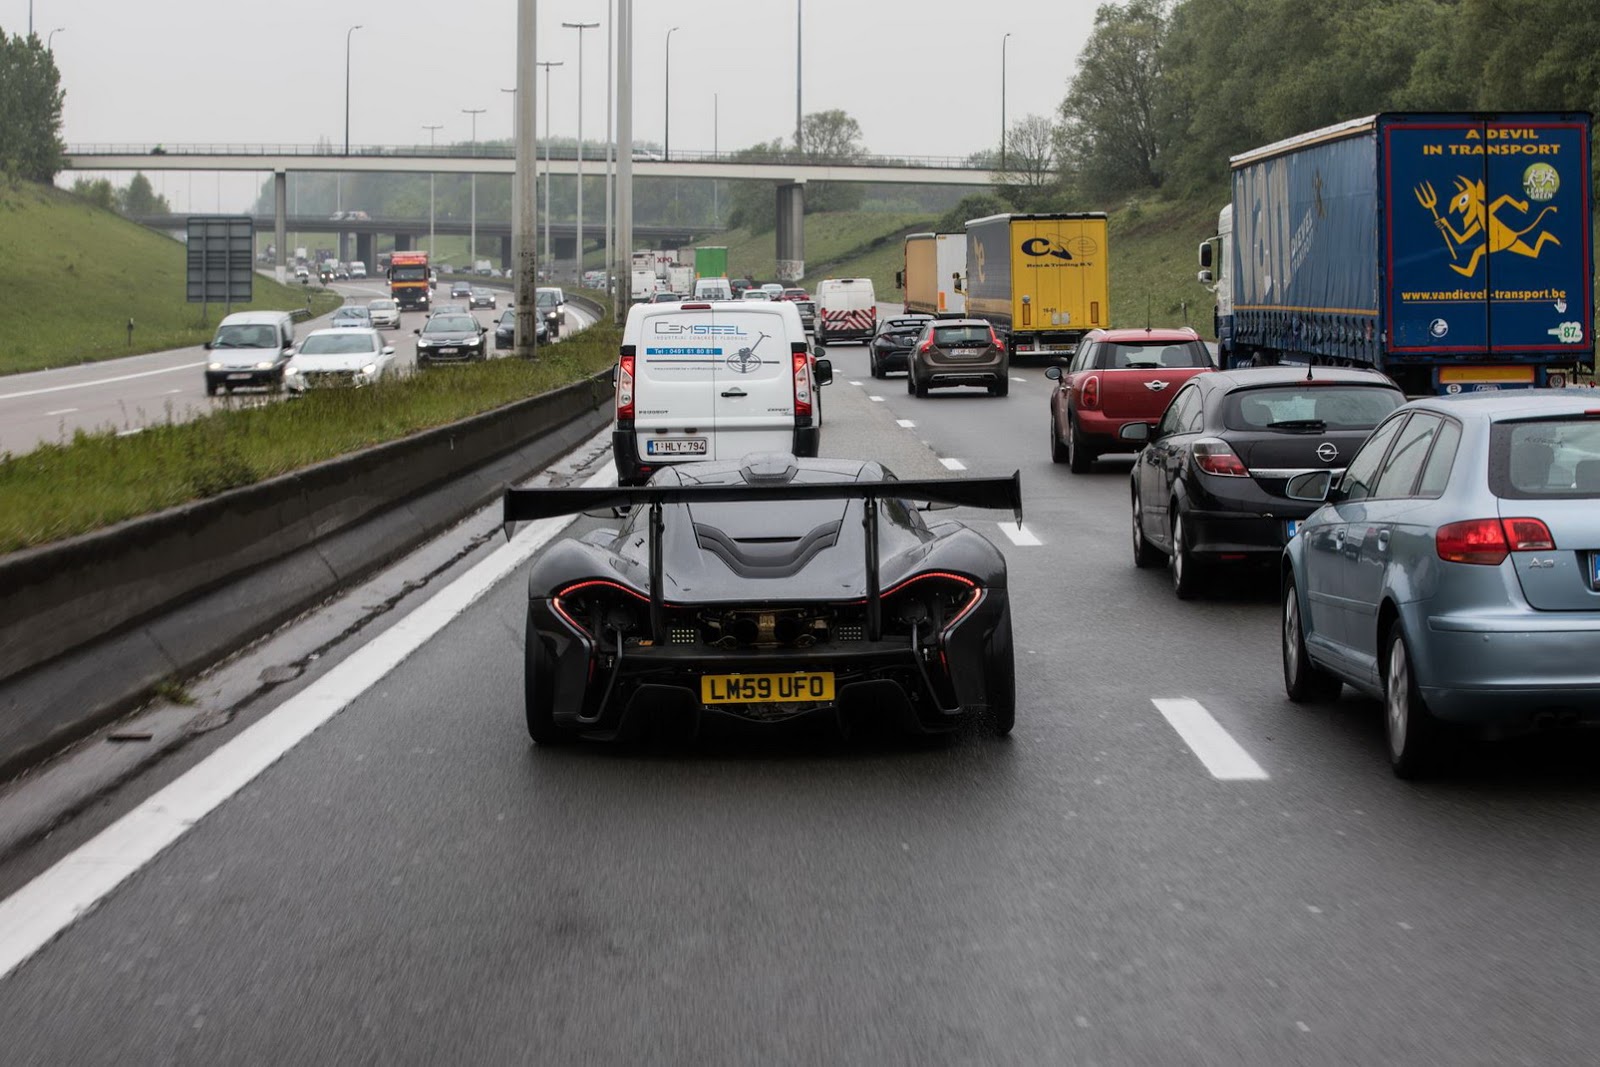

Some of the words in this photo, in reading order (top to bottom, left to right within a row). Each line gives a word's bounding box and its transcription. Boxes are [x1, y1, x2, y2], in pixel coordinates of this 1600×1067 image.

[1465, 129, 1480, 139] A
[1487, 129, 1539, 139] DEVIL
[1423, 145, 1443, 155] IN
[1448, 144, 1560, 155] TRANSPORT
[1563, 327, 1577, 338] 87
[1528, 557, 1555, 569] A3
[710, 677, 771, 700] LM59
[778, 676, 824, 698] UFO
